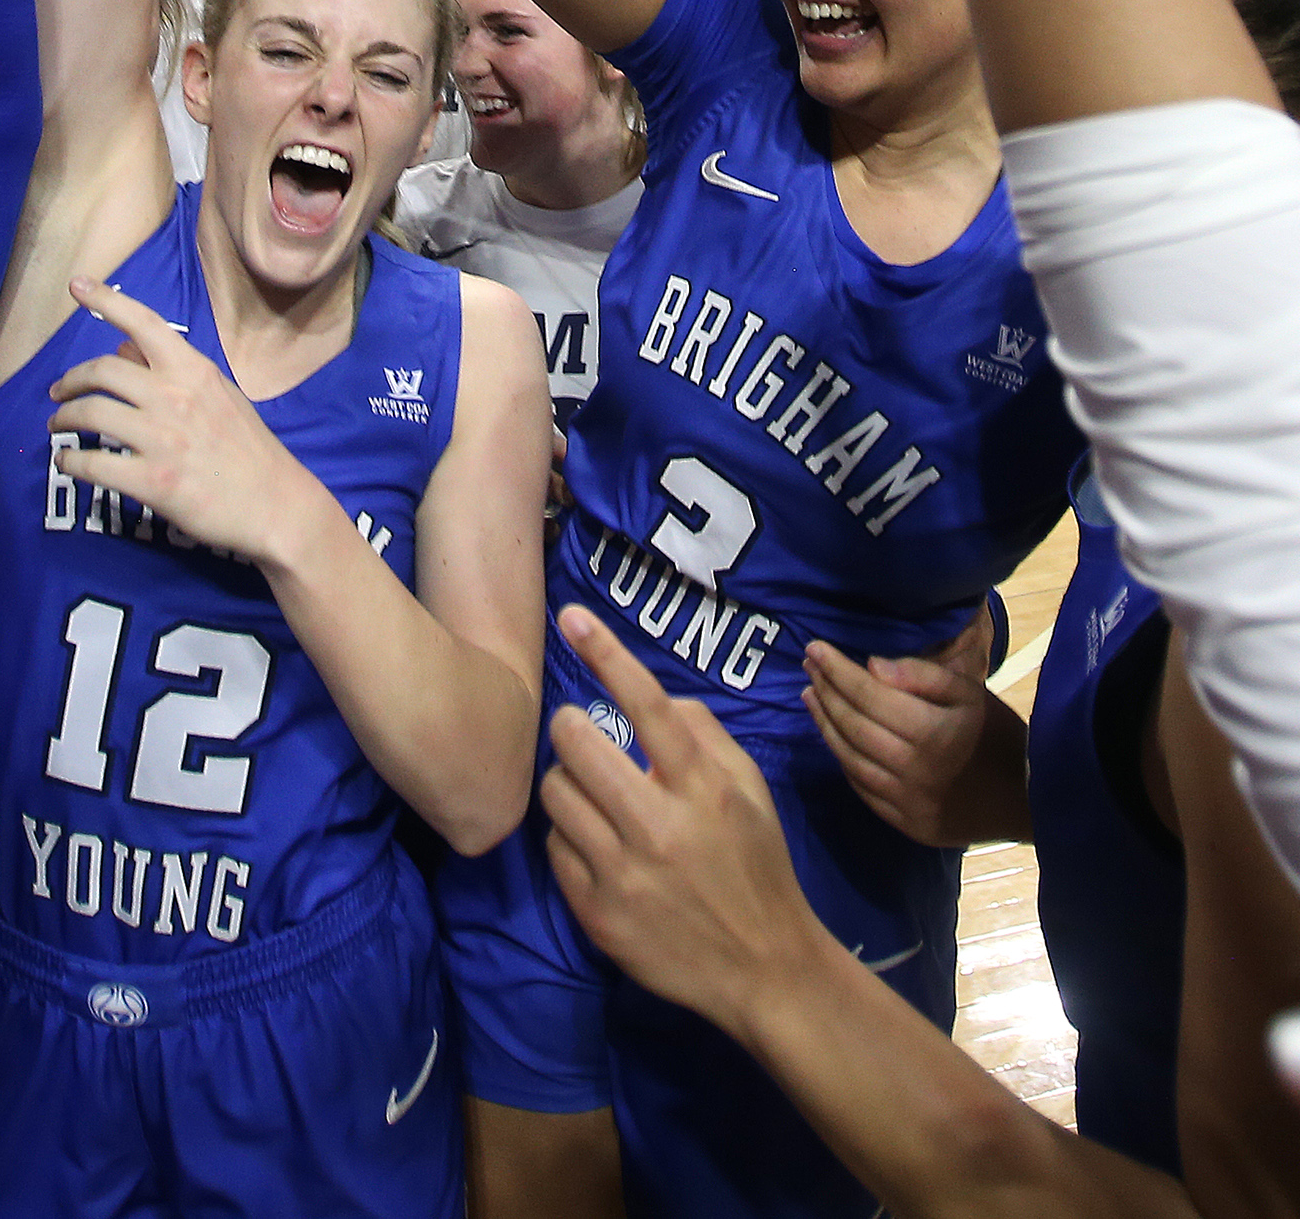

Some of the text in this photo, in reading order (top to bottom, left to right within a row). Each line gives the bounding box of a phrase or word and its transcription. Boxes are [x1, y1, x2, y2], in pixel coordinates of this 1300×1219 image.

[638, 273, 942, 538] BRIGHAM
[45, 597, 272, 814] 12
[21, 811, 251, 943] YOUNG
